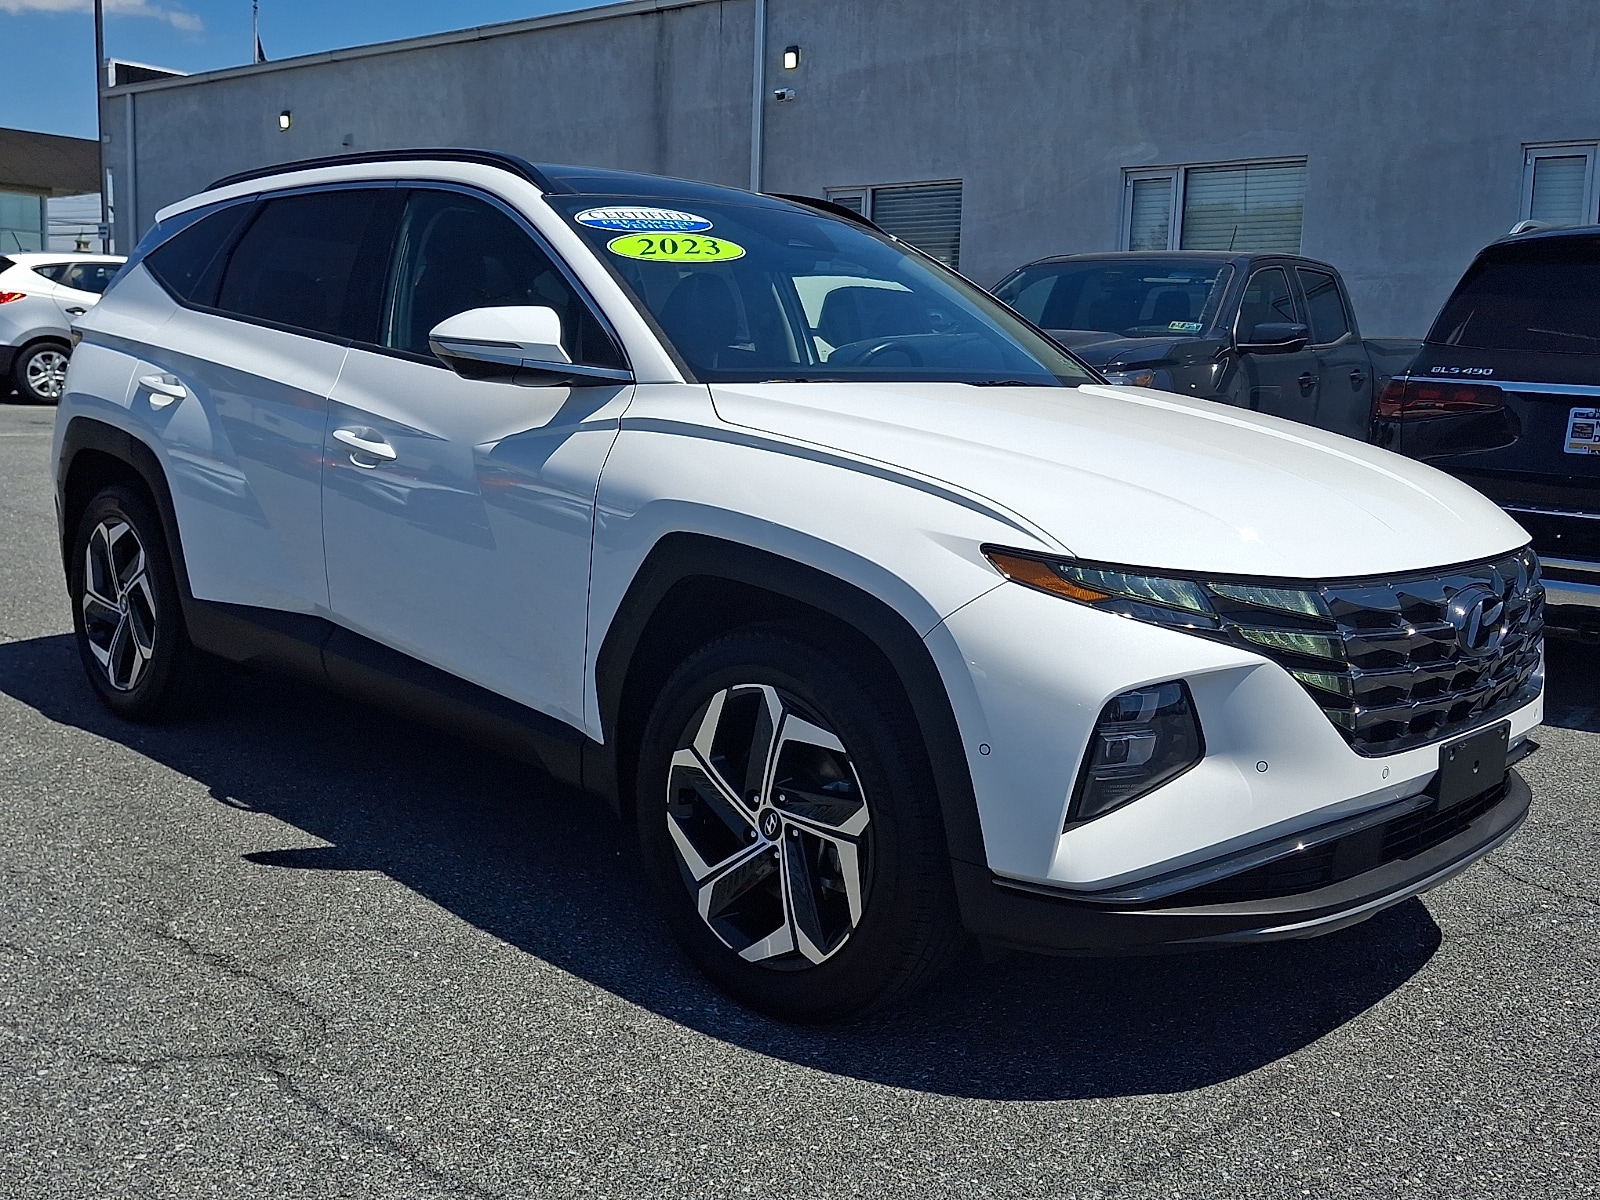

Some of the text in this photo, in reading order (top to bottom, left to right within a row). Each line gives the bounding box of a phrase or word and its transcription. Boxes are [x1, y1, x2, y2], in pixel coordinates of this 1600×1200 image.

[588, 211, 692, 221] CERTIFIED
[601, 219, 695, 227] PRE-OWNED
[621, 223, 689, 231] VEHICLE
[637, 238, 721, 256] 2023
[1430, 366, 1460, 374] GLS
